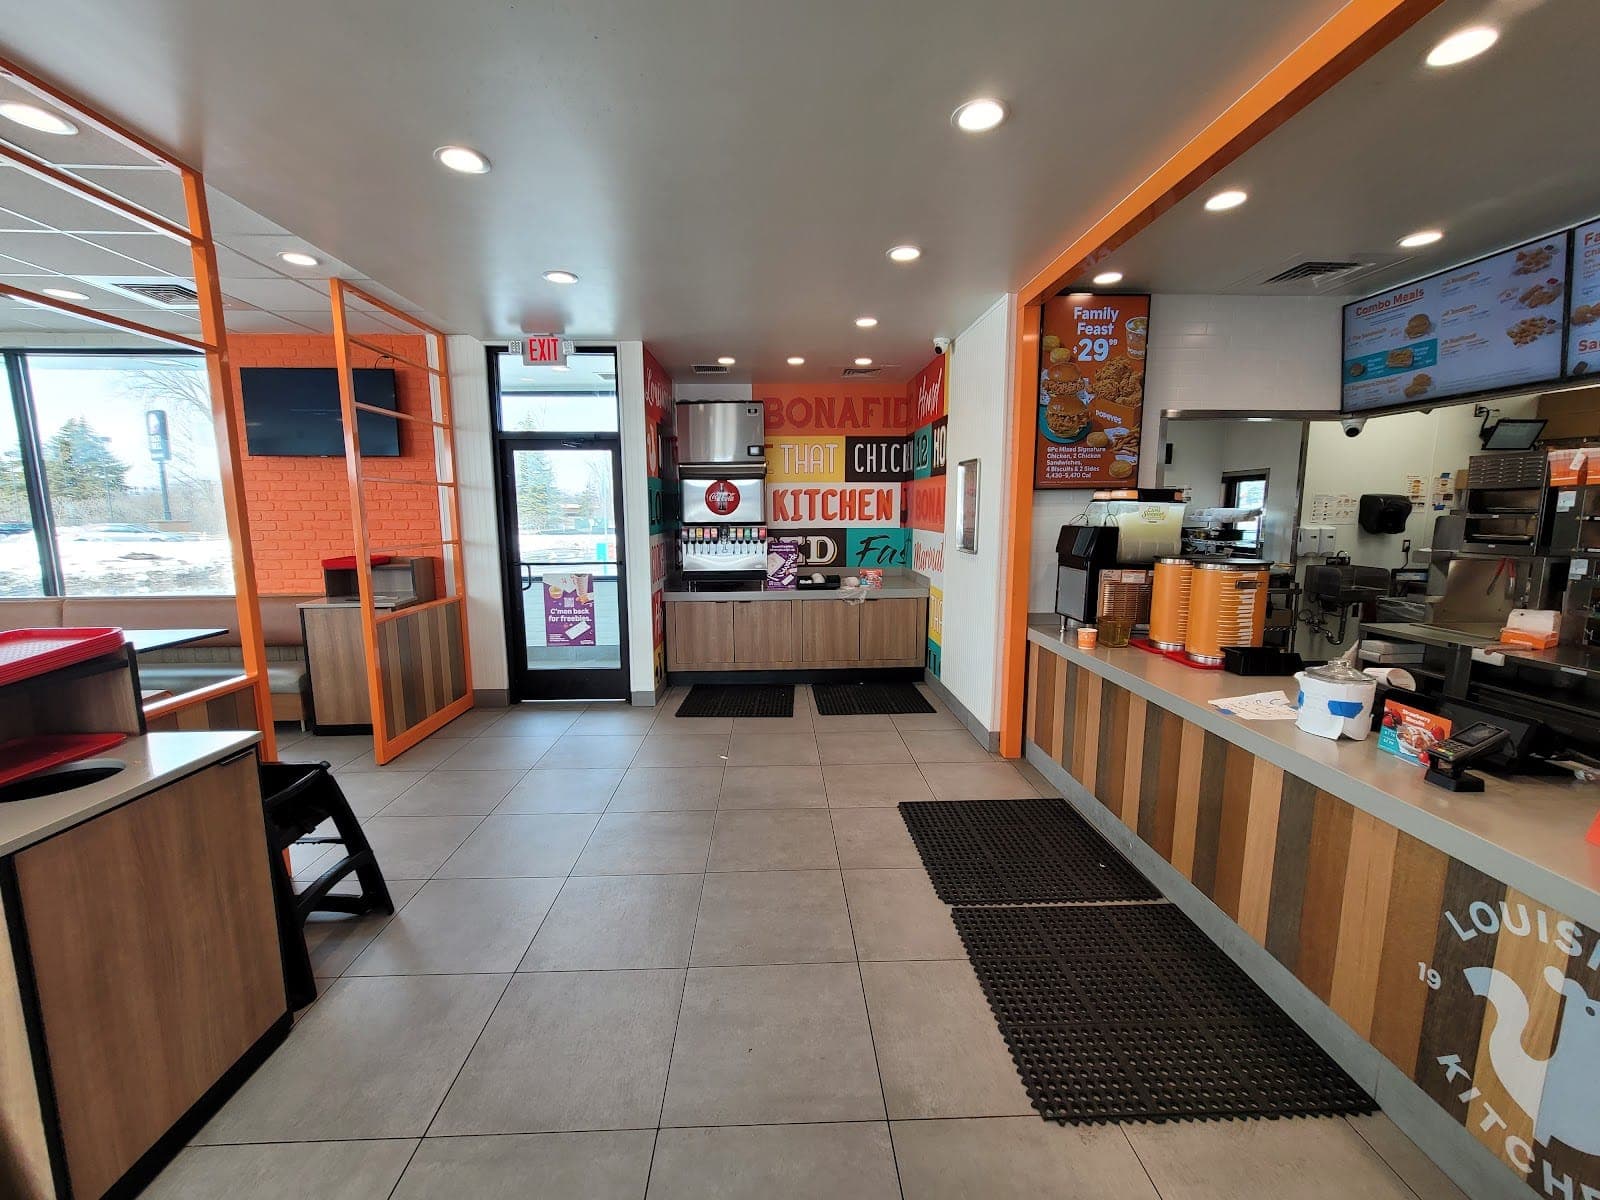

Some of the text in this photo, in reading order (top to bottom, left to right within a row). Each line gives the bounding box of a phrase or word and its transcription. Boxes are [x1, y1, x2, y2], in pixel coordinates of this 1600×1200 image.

[1356, 299, 1391, 316] Combo
[1393, 288, 1424, 305] Meals
[1074, 306, 1119, 322] Family
[1077, 322, 1114, 335] Feast
[529, 338, 559, 361] EXIT
[780, 443, 838, 474] THAT
[1078, 446, 1106, 454] Signature
[772, 488, 893, 522] KITCHEN
[550, 607, 590, 615] C'mon back
[1417, 961, 1442, 990] 19
